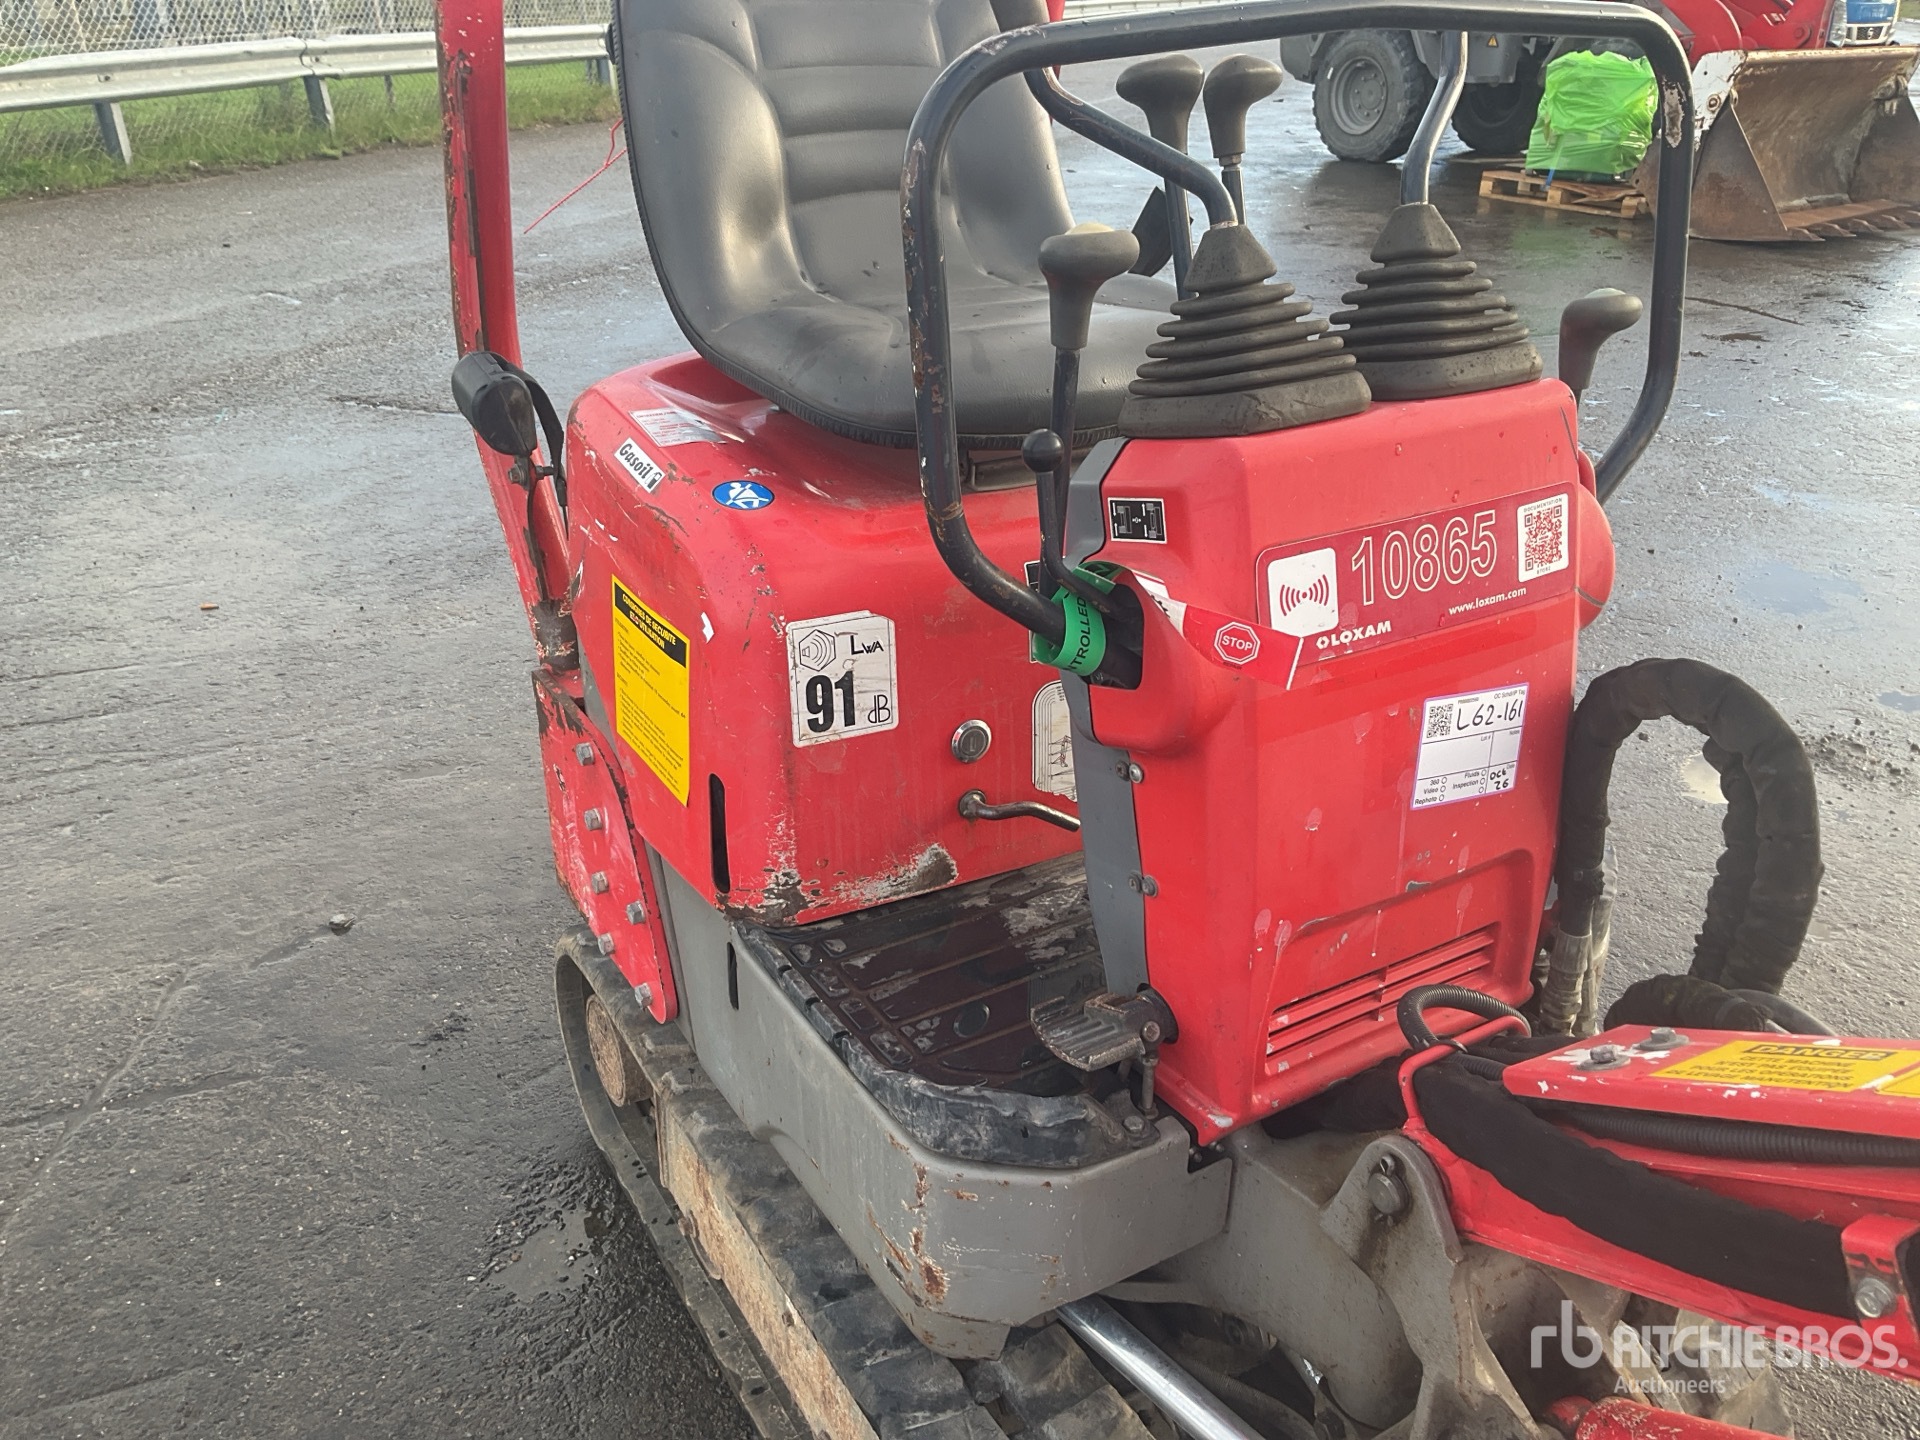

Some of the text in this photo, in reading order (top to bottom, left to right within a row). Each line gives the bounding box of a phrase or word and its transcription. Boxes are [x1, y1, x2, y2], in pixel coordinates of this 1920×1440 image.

[619, 443, 654, 480] Gasoil
[1523, 498, 1563, 513] DOCUMENTATION
[1351, 509, 1497, 606] 10865
[1448, 587, 1527, 615] www.loxam.com
[1330, 620, 1392, 648] LOXAM
[1222, 635, 1253, 651] STOP
[805, 670, 856, 733] 91
[867, 694, 891, 724] dB
[1456, 699, 1524, 731] L62-161
[1429, 779, 1440, 787] 360
[1464, 771, 1480, 779] Fluids
[1423, 787, 1439, 795] Video
[1452, 780, 1479, 789] Inspection
[1415, 796, 1438, 806] Rephoto
[1752, 1045, 1888, 1060] DANGER
